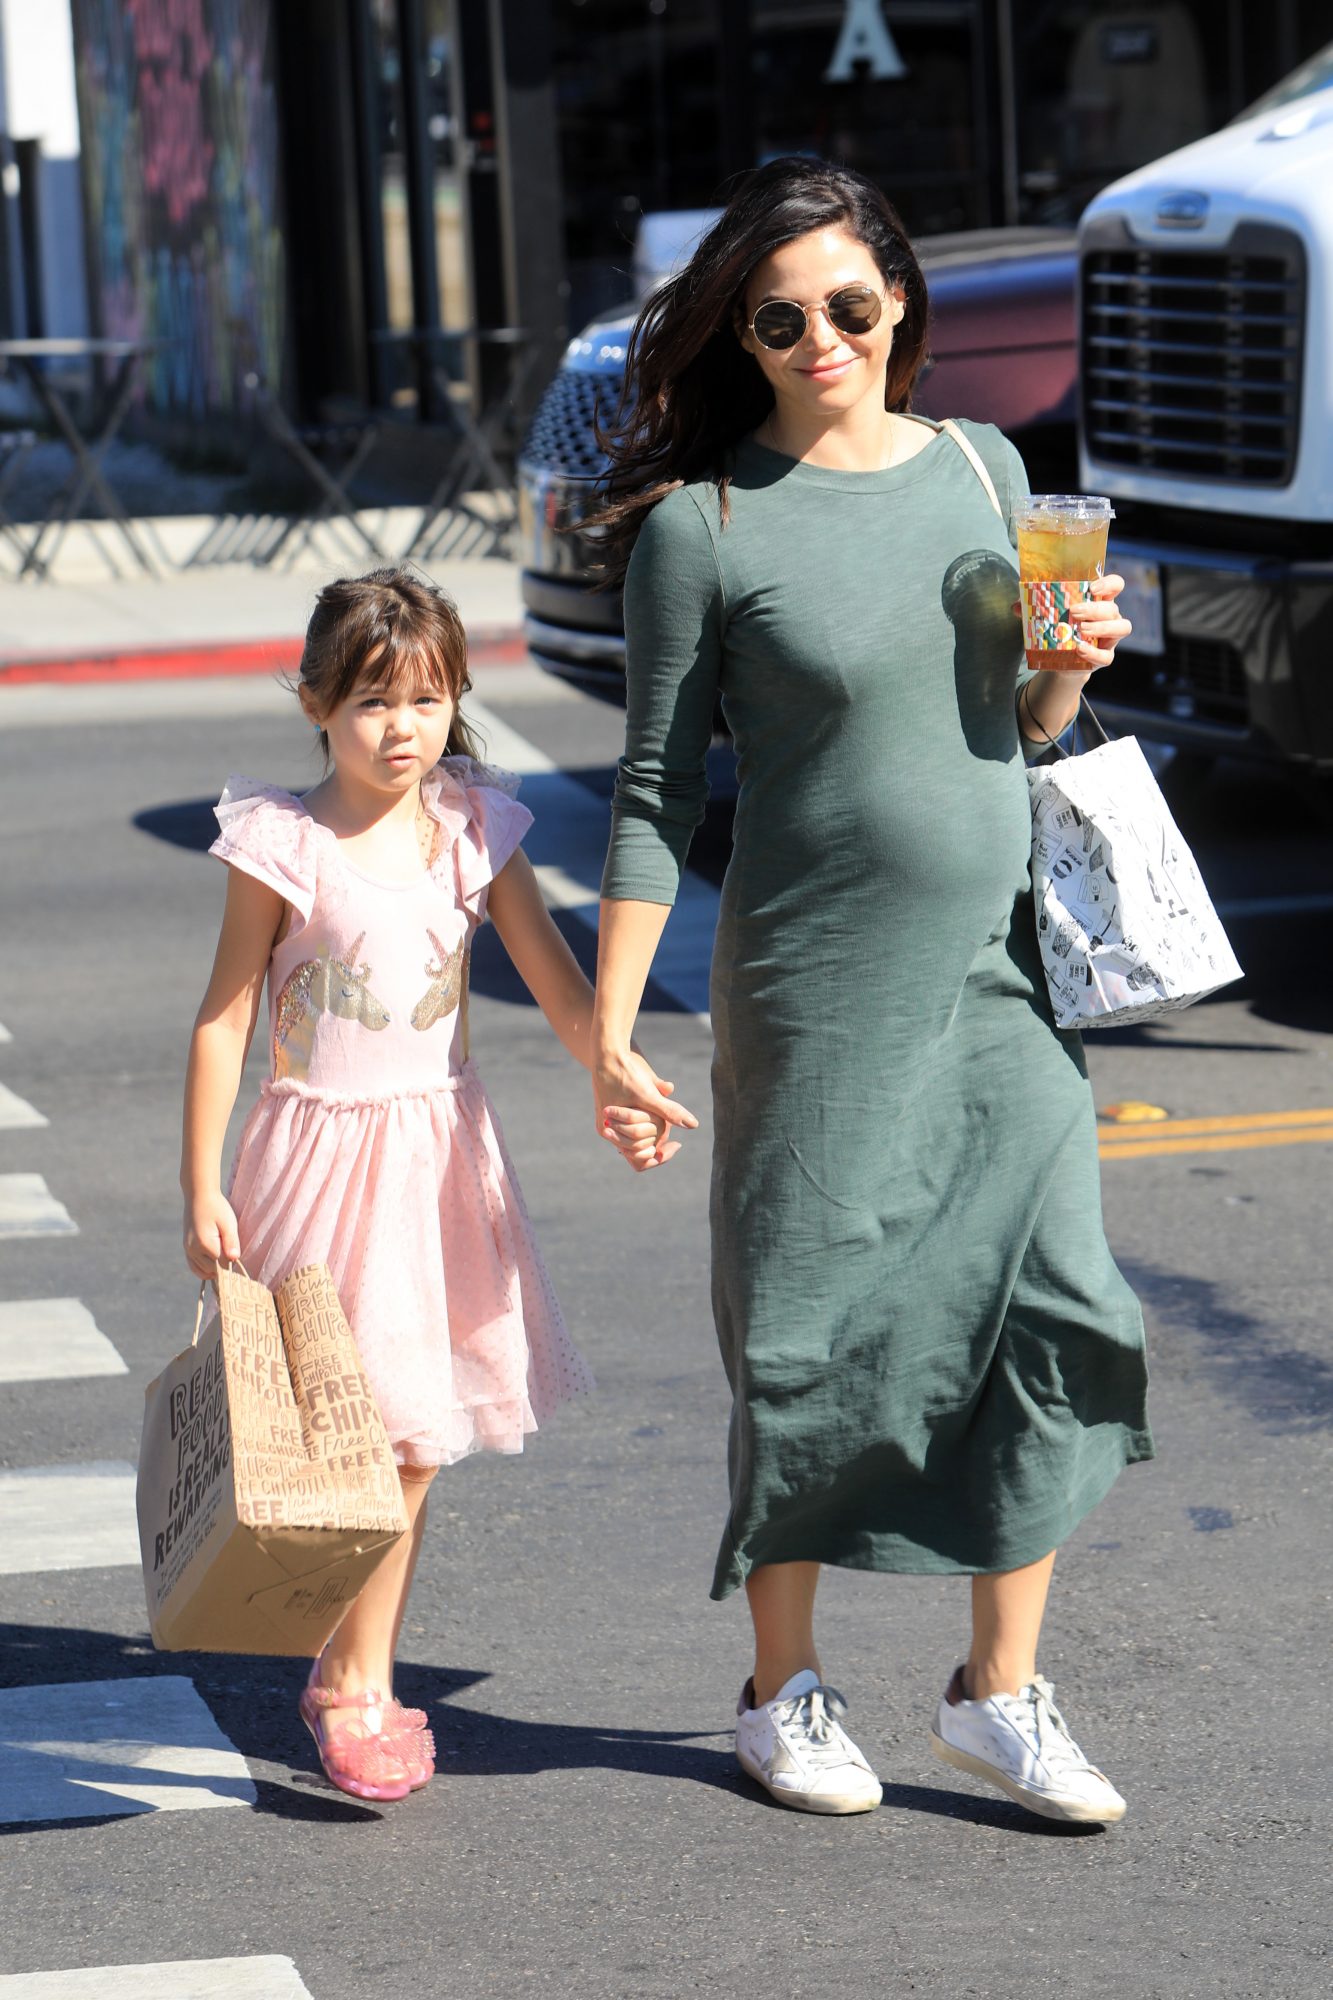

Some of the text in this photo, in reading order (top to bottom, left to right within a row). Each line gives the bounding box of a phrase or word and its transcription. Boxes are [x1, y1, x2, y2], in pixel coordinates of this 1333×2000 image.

[826, 0, 908, 82] A
[285, 1290, 338, 1334] FREE
[300, 1353, 340, 1378] FREE
[303, 1364, 343, 1387] CHIPOTLE
[170, 1339, 222, 1440] REAL
[177, 1379, 224, 1479] FOOD
[327, 1446, 386, 1472] FREE
[153, 1436, 231, 1572] REWARDING
[168, 1478, 182, 1518] IS
